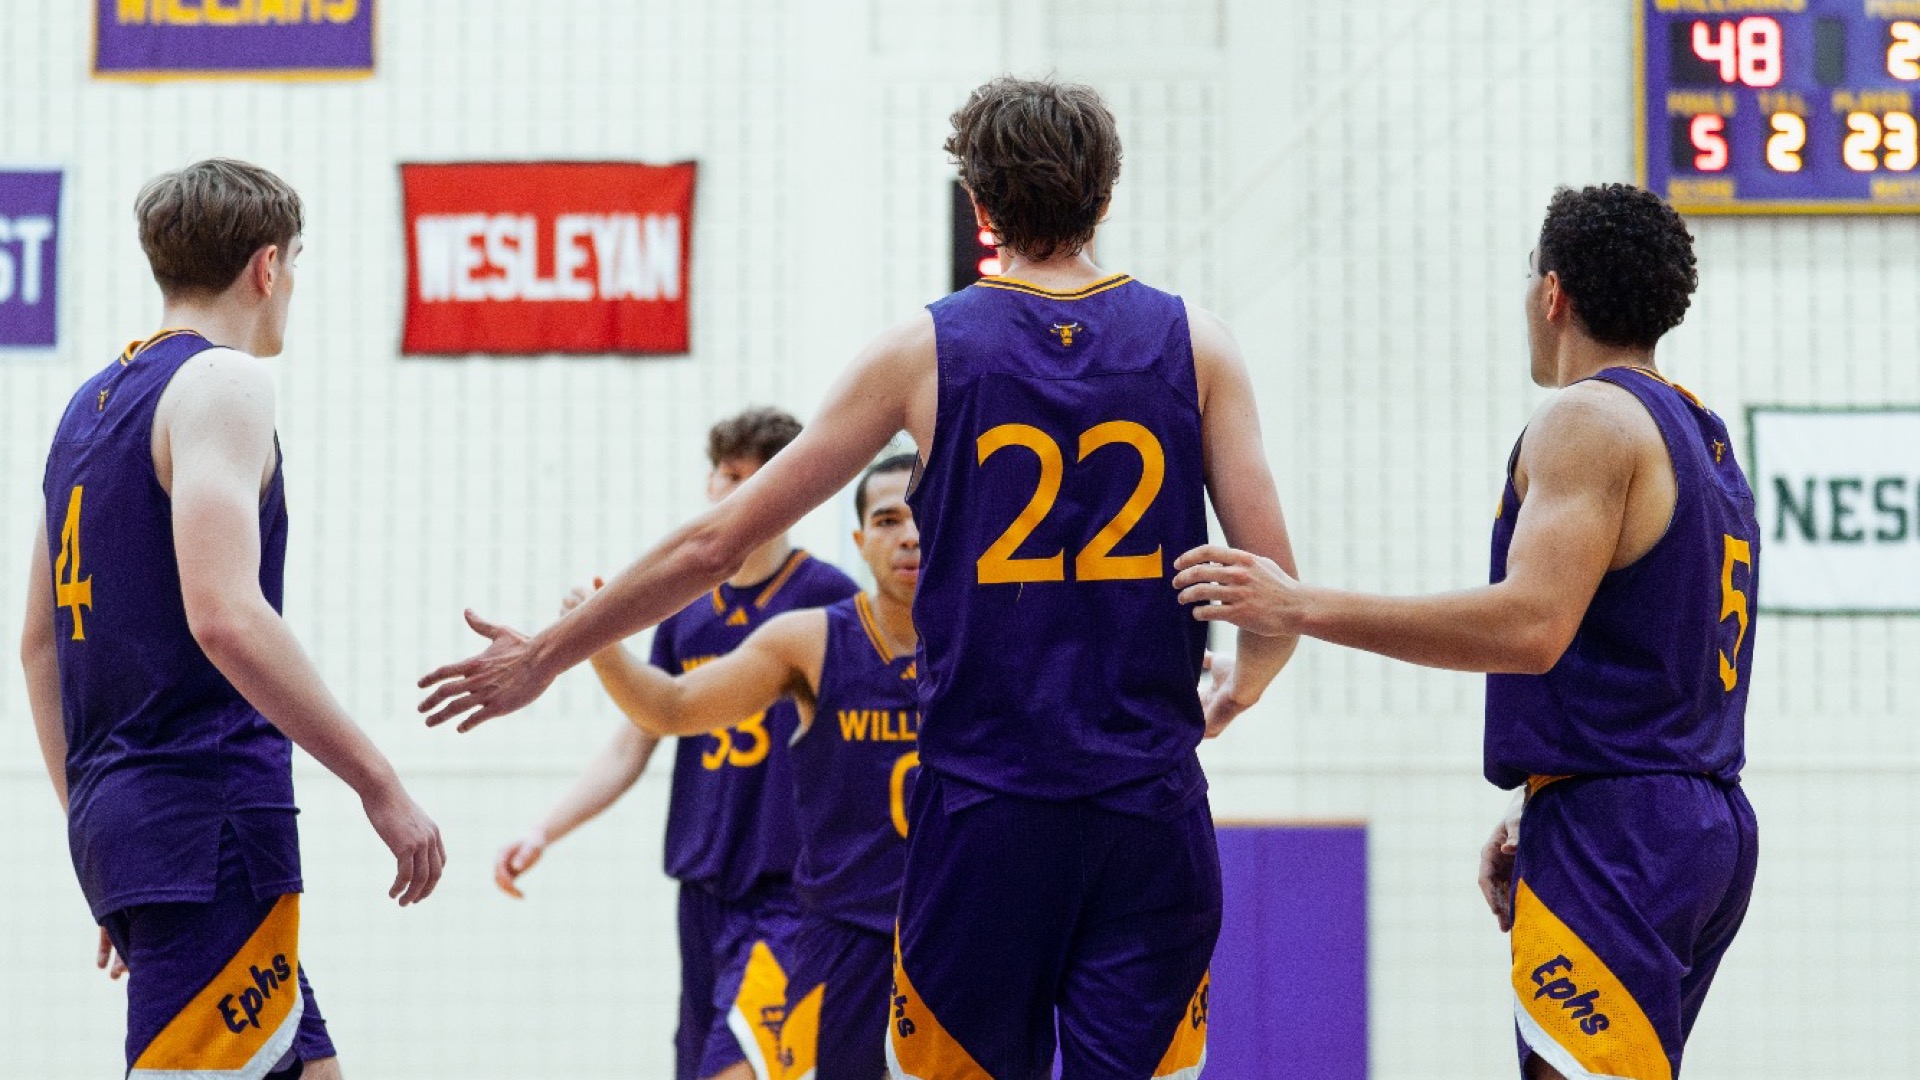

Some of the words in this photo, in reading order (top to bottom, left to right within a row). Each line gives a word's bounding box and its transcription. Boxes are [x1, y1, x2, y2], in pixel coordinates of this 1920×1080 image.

[1692, 17, 1782, 87] 48
[1887, 21, 1920, 80] 2
[1690, 113, 1728, 171] 5
[1766, 112, 1806, 172] 2
[1843, 111, 1918, 172] 23
[415, 213, 681, 302] WESLEYAN
[976, 420, 1165, 584] 22
[1773, 475, 1920, 542] NES
[56, 486, 92, 640] 4
[1719, 534, 1752, 692] 5
[217, 953, 291, 1034] Ephs
[1531, 954, 1610, 1036] Ephs
